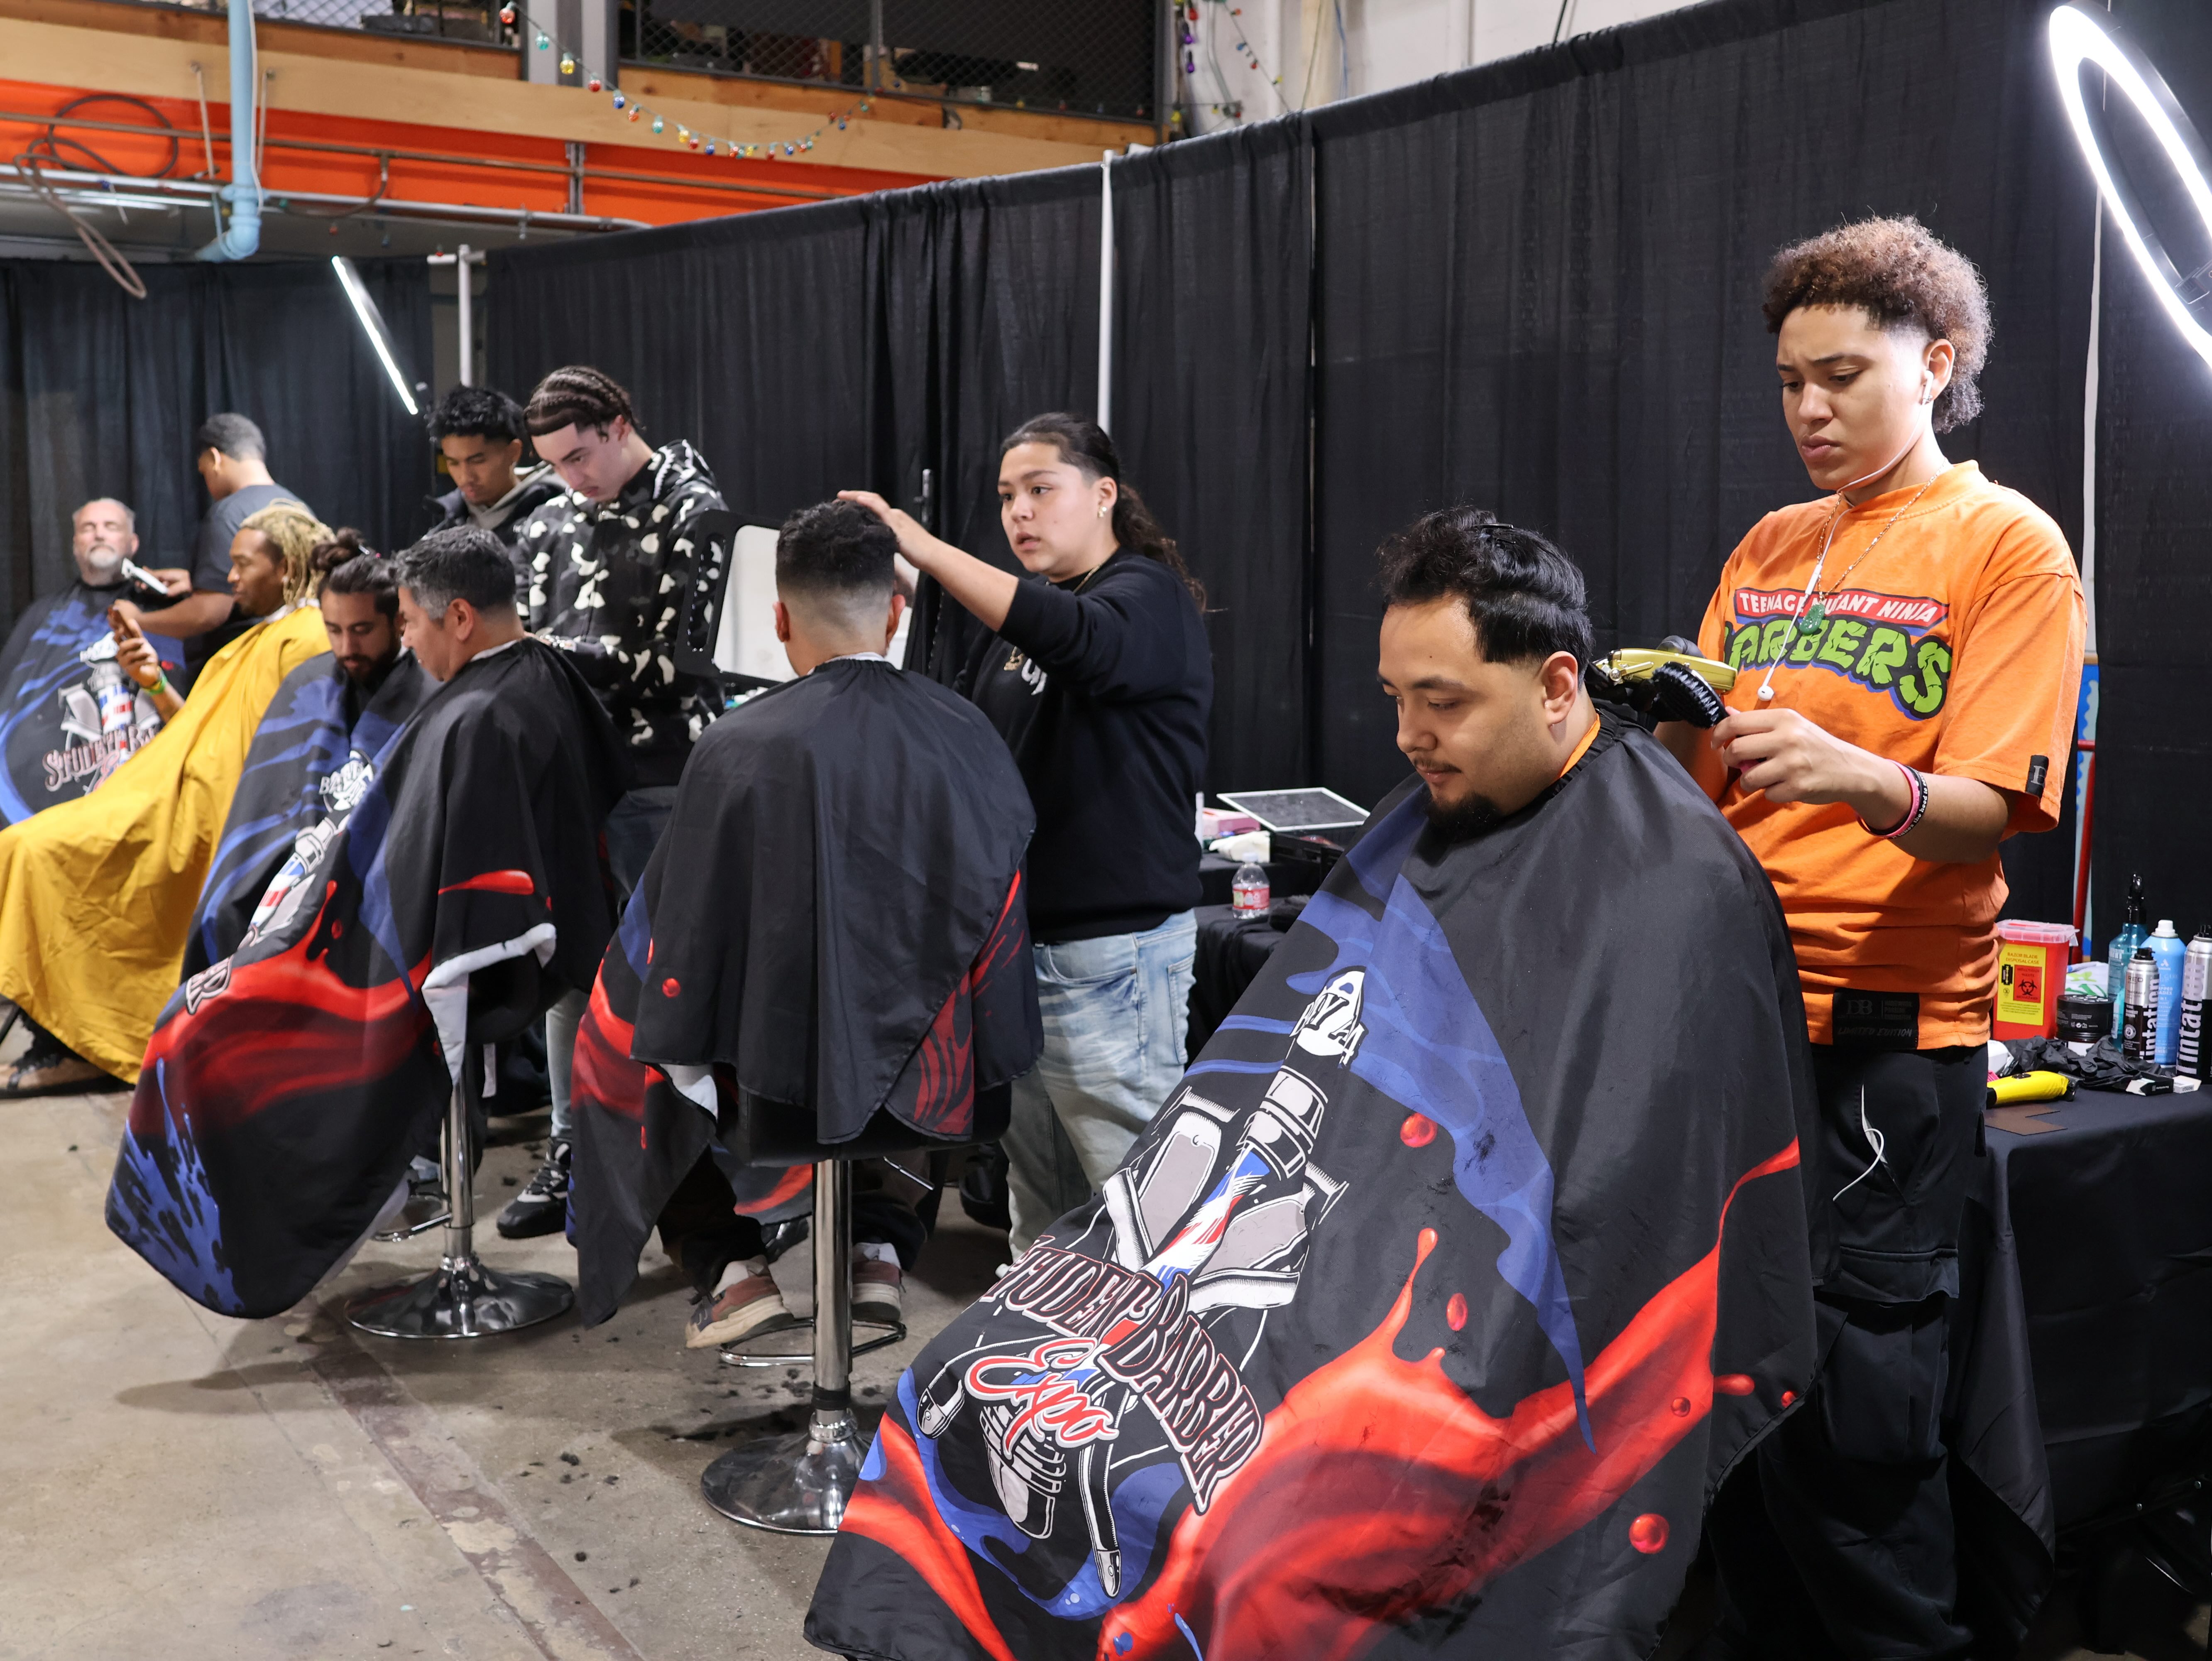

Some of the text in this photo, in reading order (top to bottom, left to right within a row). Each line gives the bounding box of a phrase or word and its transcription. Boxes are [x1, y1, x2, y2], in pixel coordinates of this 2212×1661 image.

[1740, 593, 1806, 613] TEENAGE
[1876, 600, 1938, 622] NINJA
[1725, 619, 1952, 713] ARBERS
[1913, 813, 1922, 823] the
[1919, 795, 1928, 813] hood
[1877, 1028, 1912, 1037] EDITION
[966, 1336, 1120, 1460] Expo
[979, 1234, 1262, 1514] TUDENT BARBER
